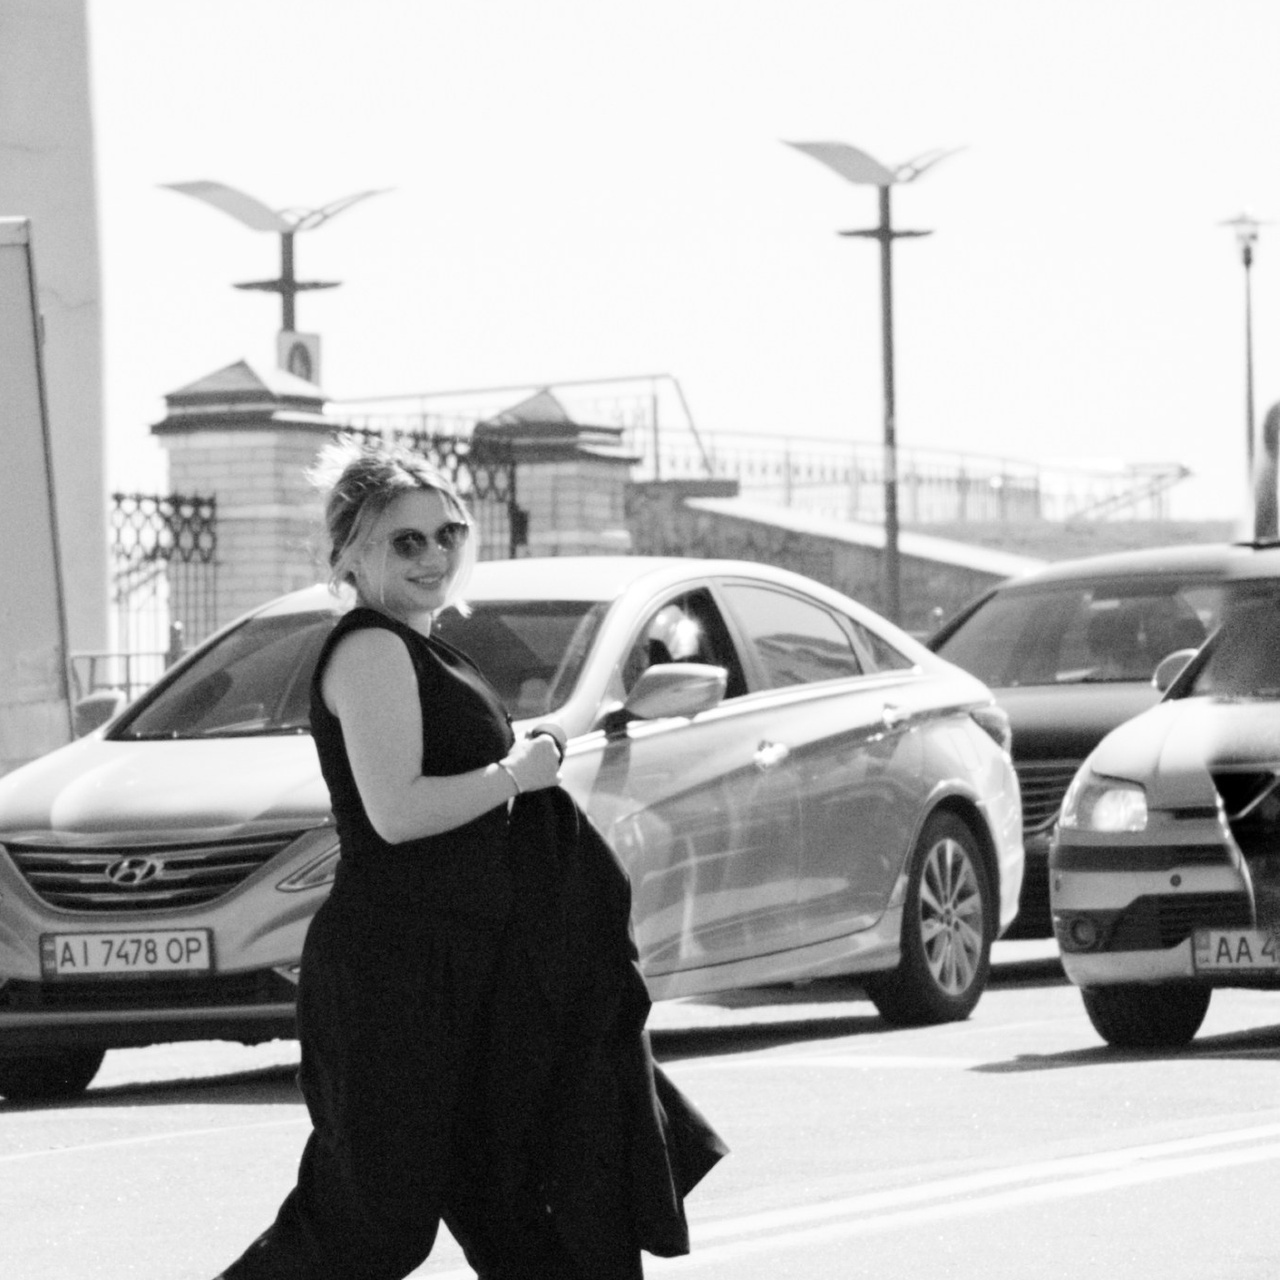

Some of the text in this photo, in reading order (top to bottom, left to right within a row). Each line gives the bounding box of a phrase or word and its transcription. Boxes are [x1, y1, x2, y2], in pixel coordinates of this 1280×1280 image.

[101, 938, 158, 966] 7478
[166, 937, 202, 964] OP
[1216, 936, 1253, 963] AA
